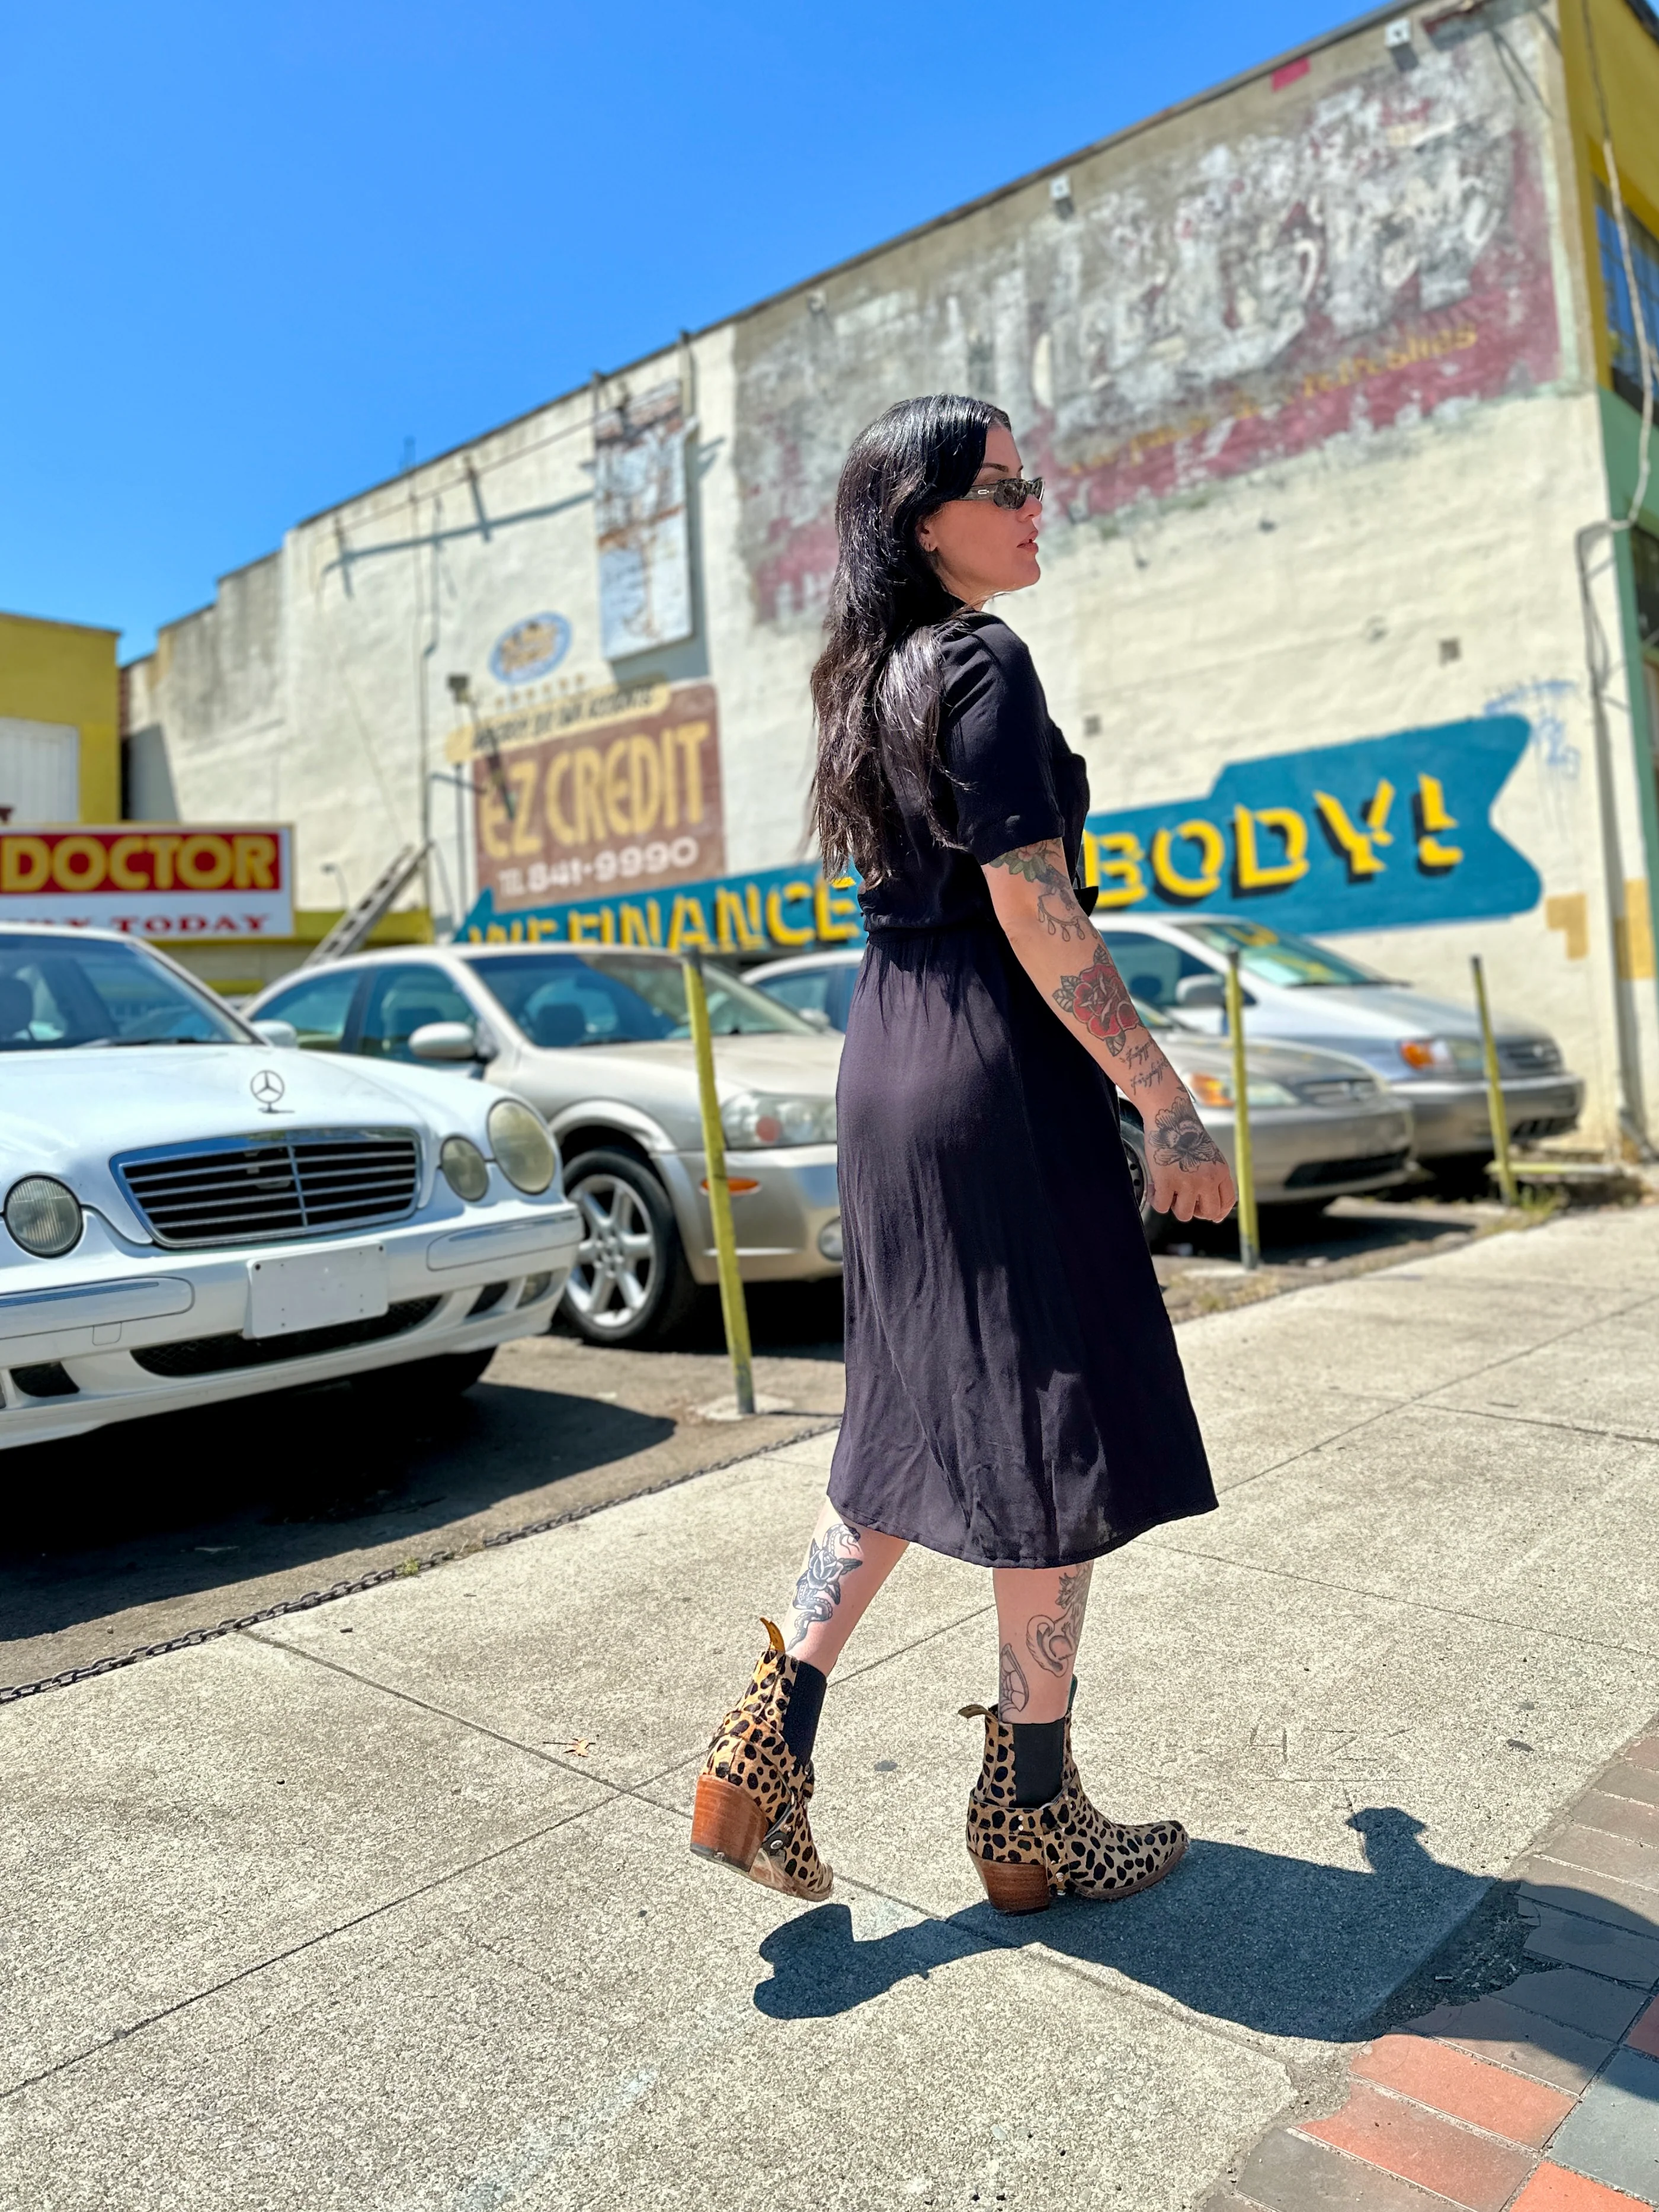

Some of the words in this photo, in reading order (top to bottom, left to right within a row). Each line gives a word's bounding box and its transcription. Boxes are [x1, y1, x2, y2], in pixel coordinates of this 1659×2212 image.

[545, 720, 710, 847] CREDIT
[1, 834, 276, 892] DOCTOR
[1082, 772, 1463, 909] BODY!
[110, 913, 270, 933] TODAY
[568, 873, 860, 952] FINANCE
